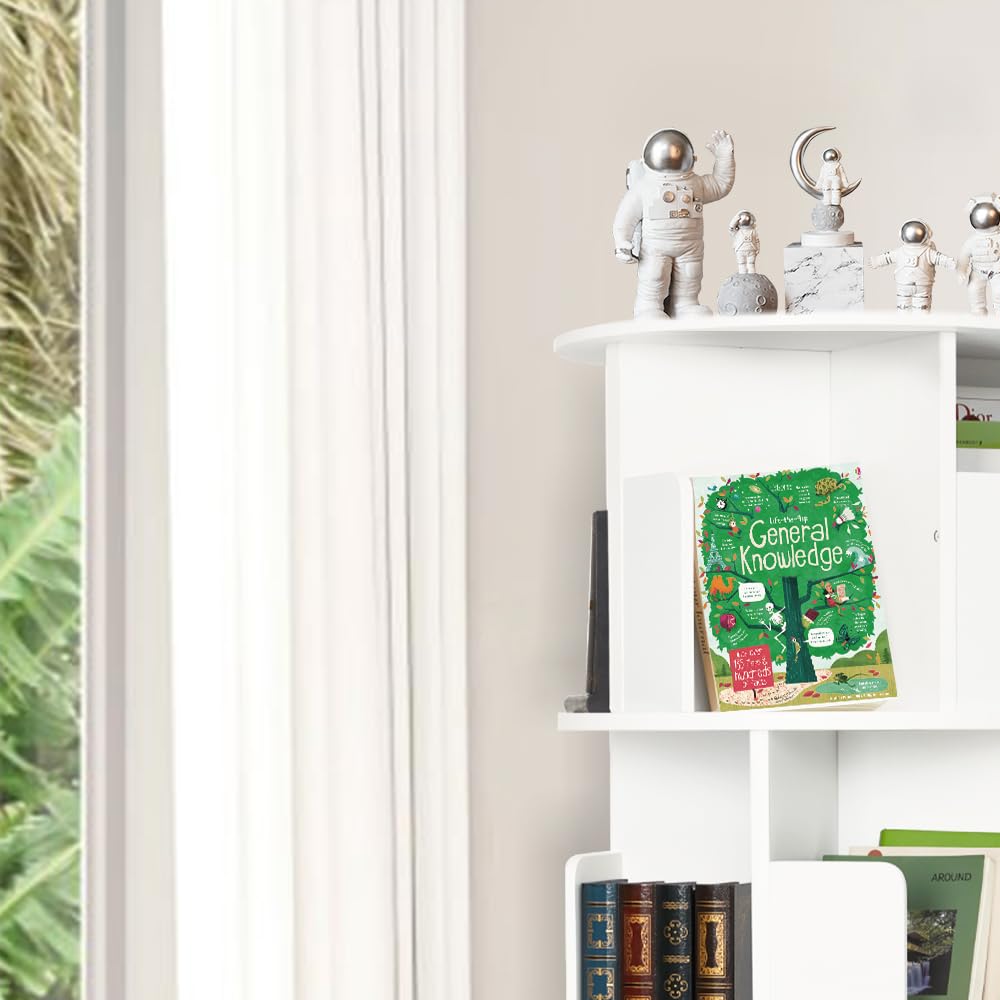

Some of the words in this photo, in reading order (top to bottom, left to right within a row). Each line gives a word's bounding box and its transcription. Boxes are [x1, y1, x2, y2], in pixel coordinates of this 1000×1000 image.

[749, 516, 829, 548] General
[739, 541, 843, 575] Knowledge
[931, 872, 972, 882] AROUND
